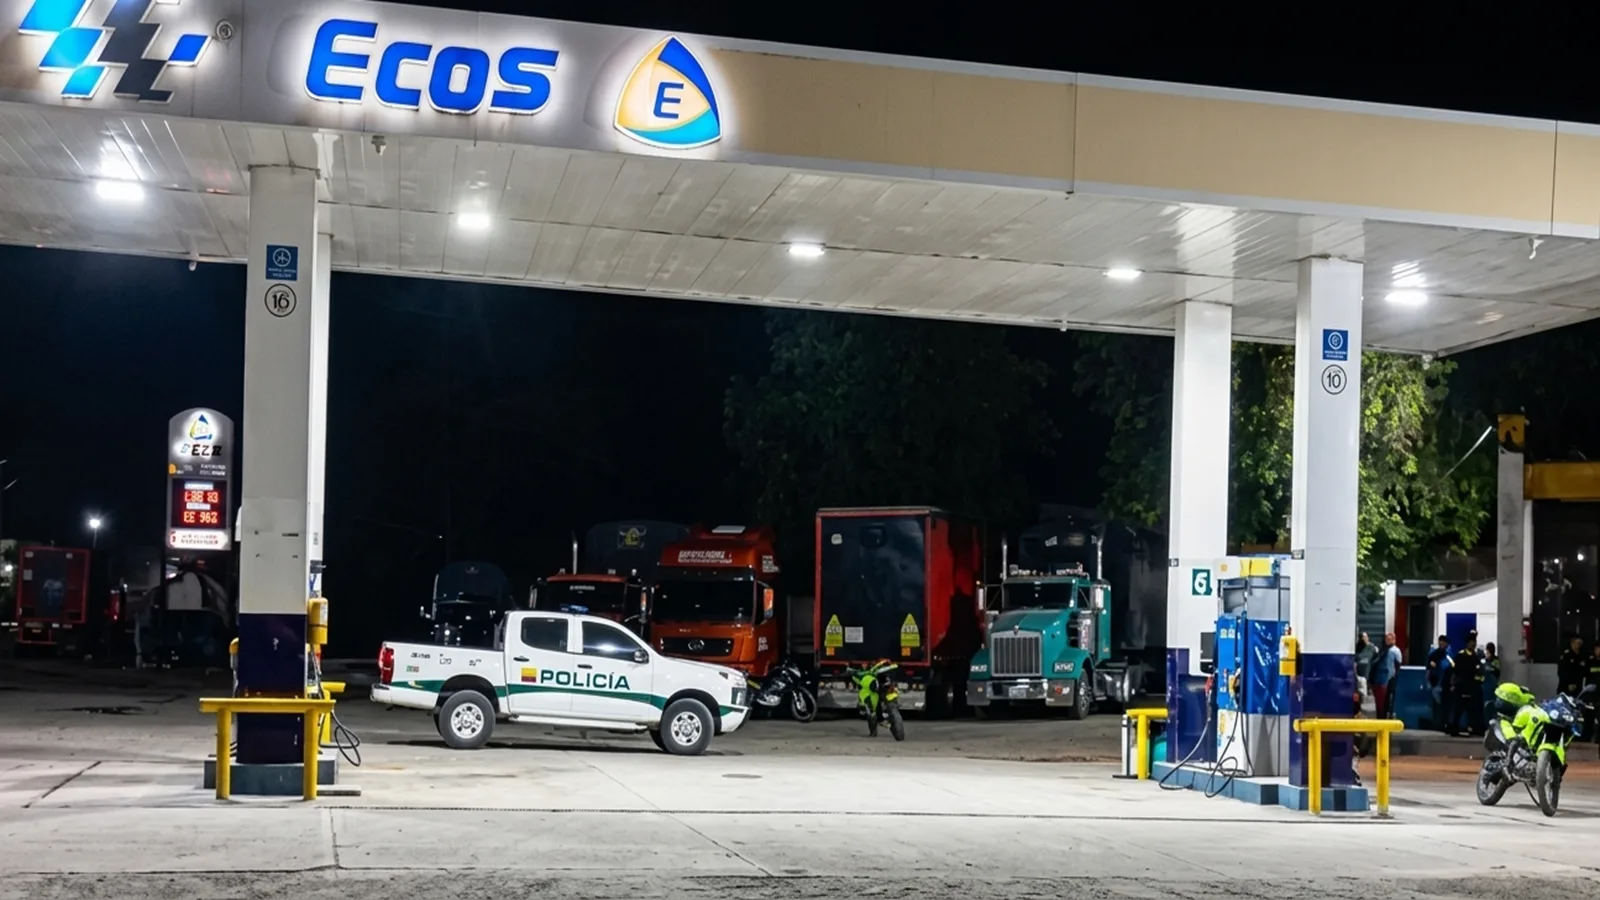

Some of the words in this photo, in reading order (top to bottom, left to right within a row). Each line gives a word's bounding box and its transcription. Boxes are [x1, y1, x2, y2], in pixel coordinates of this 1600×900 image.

[654, 82, 684, 119] E
[272, 293, 290, 310] 16
[1326, 372, 1341, 388] 10
[540, 669, 630, 690] POLICÍA
